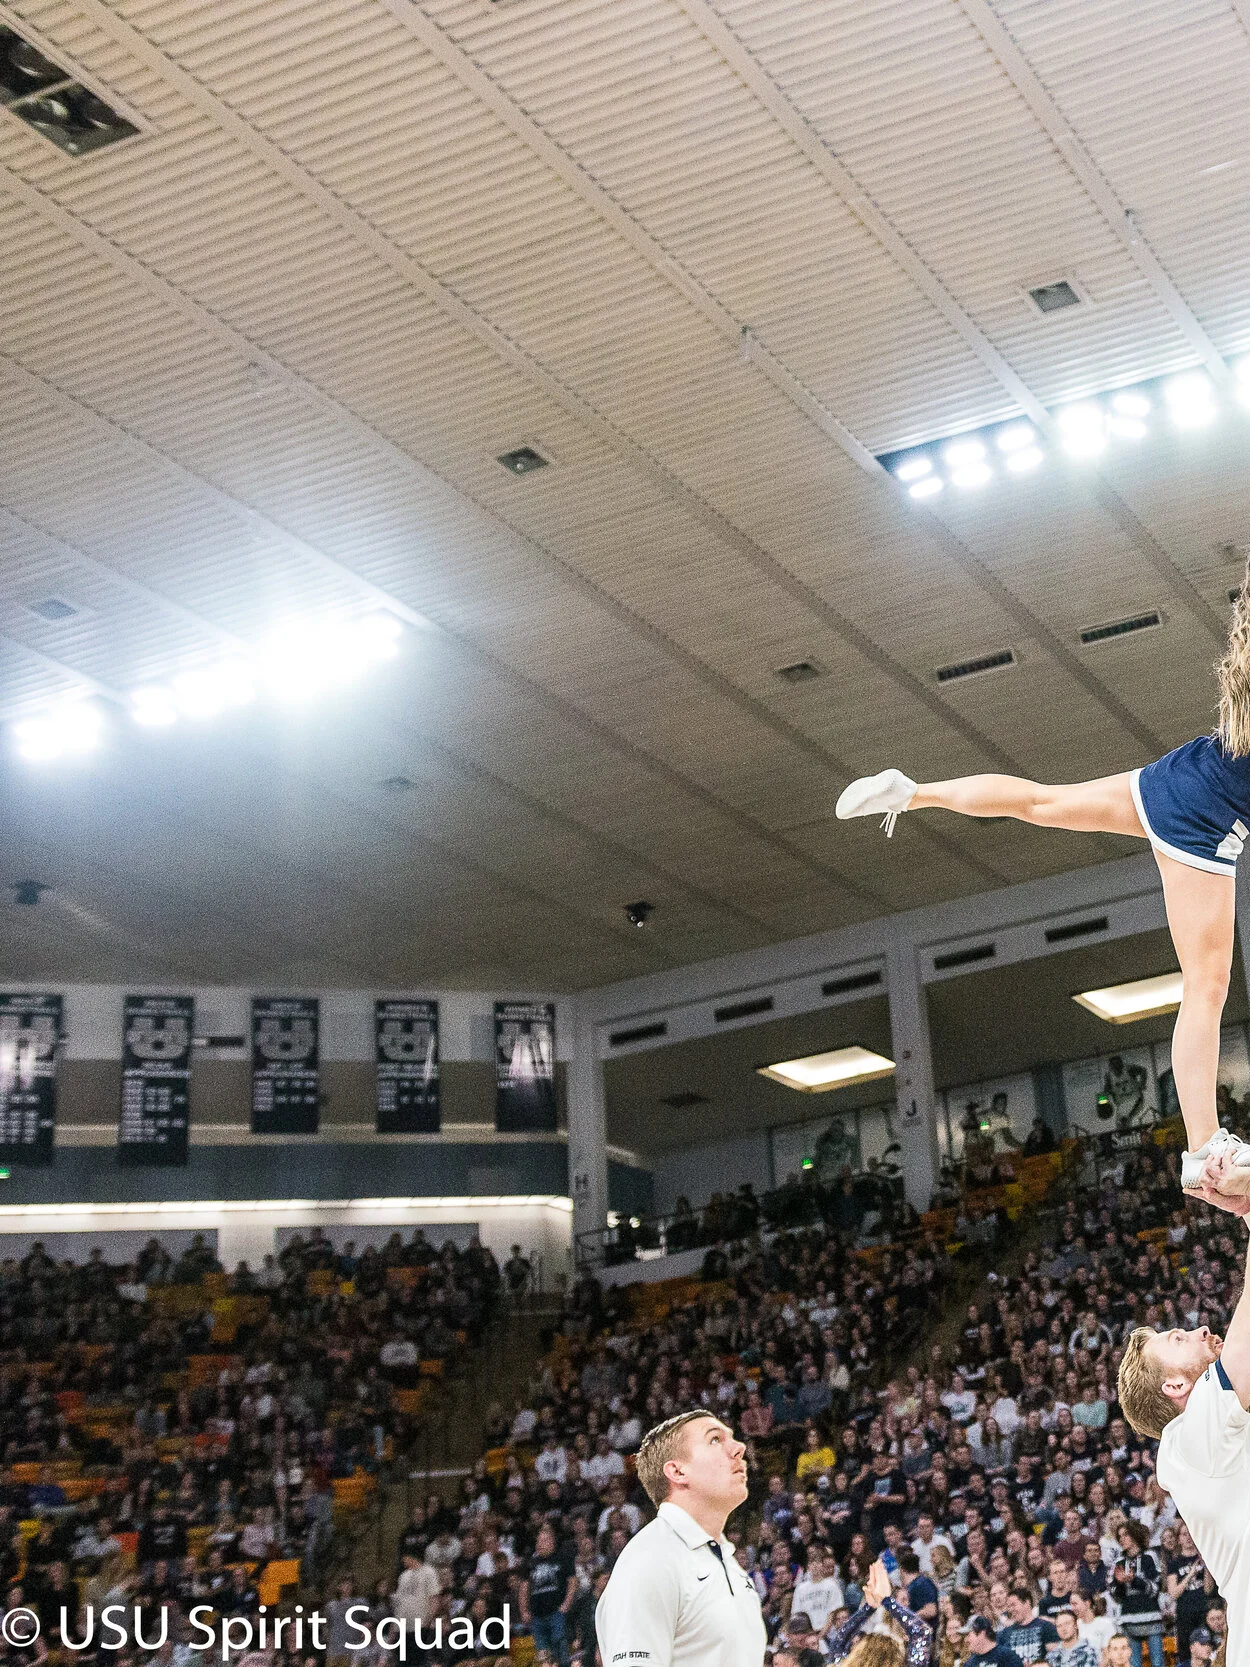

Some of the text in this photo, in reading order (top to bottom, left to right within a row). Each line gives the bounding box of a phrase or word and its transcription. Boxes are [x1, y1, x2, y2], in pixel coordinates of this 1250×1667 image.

[905, 1099, 917, 1117] J
[574, 1173, 590, 1192] H
[629, 1651, 650, 1659] STATE
